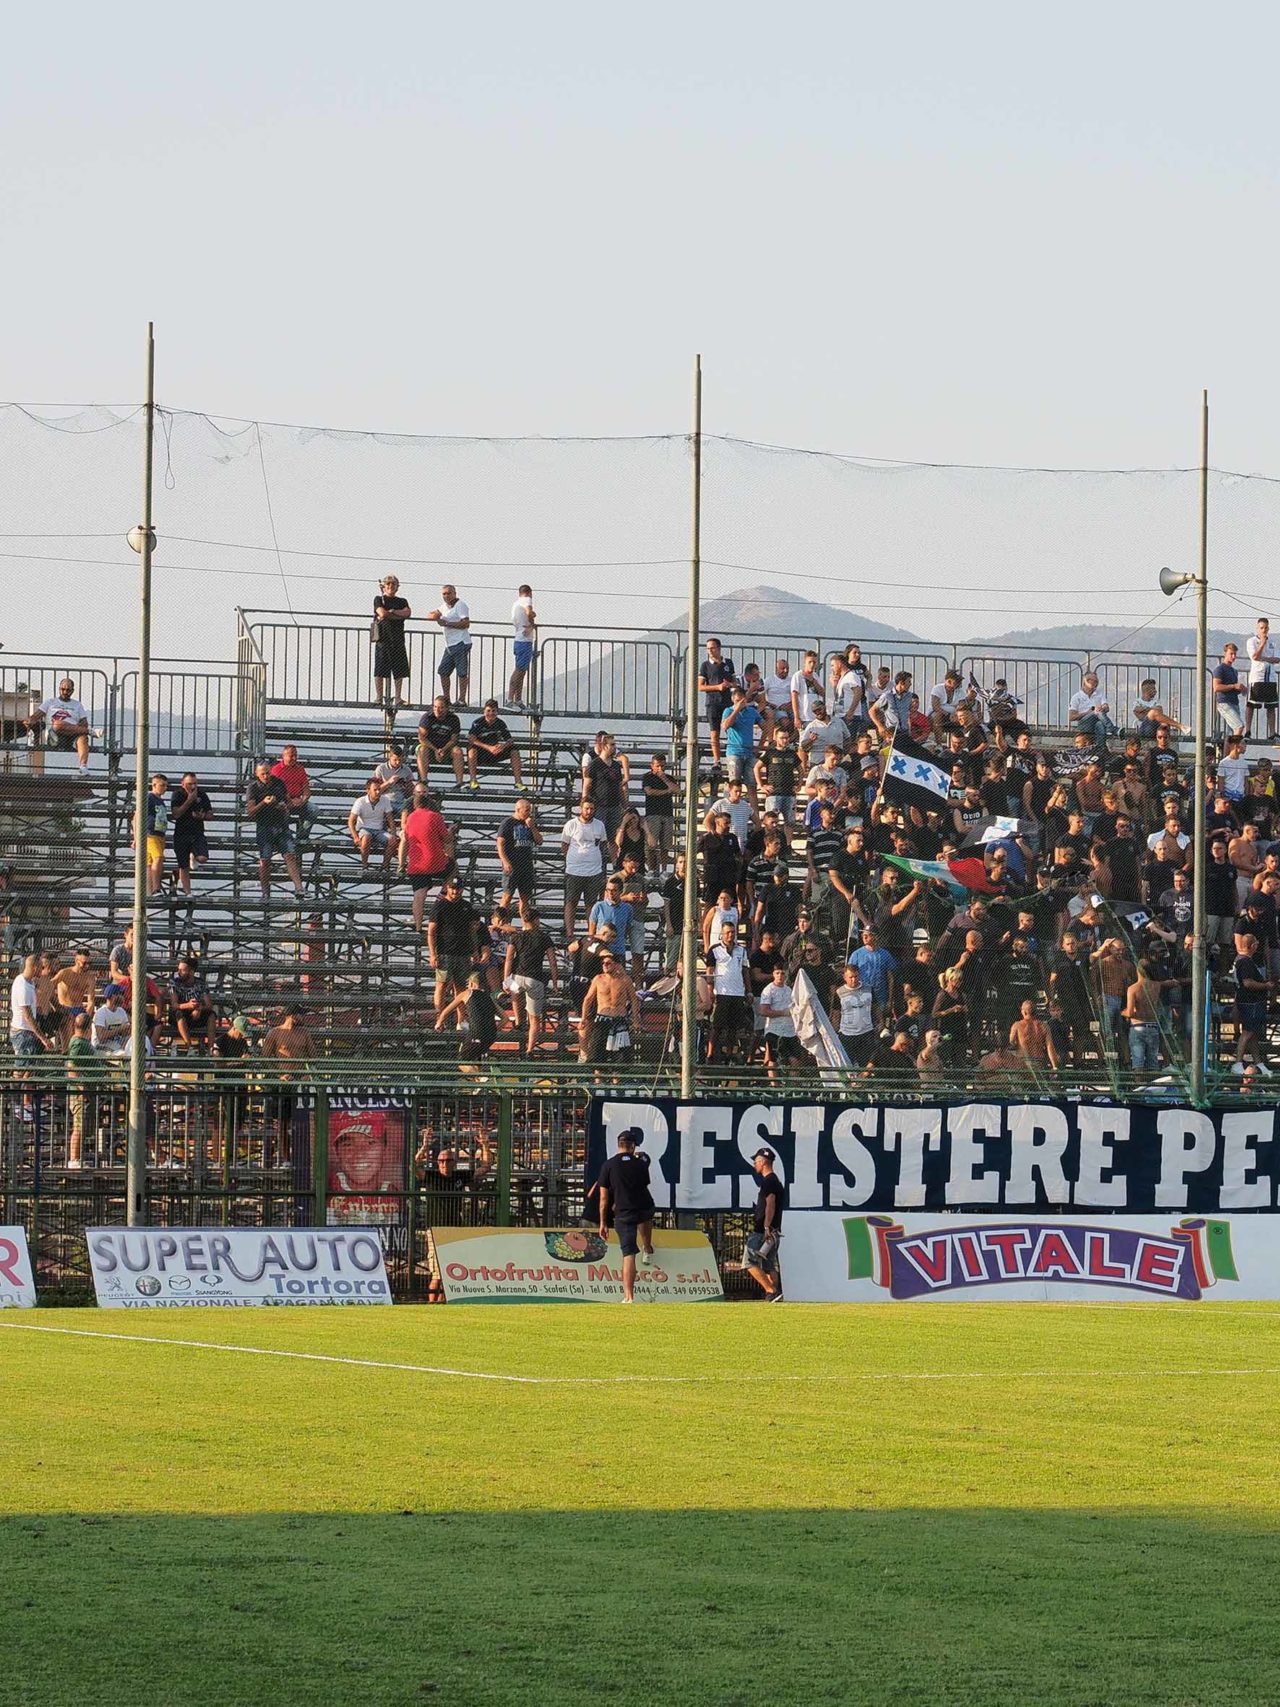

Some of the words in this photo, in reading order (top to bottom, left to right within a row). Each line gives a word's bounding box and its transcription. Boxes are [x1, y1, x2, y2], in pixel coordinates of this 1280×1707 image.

[603, 1102, 1130, 1210] RESISTERE
[92, 1234, 238, 1273] SUPER
[262, 1234, 381, 1272] AUTO
[898, 1227, 1187, 1290] VITALE
[269, 1274, 387, 1294] Tortora
[446, 1263, 580, 1281] Ortofrutta
[677, 1269, 717, 1284] s.r.l.
[449, 1284, 461, 1294] Via
[463, 1285, 486, 1294] Nuova
[544, 1284, 568, 1294] Scafati
[590, 1285, 604, 1294] Tel.
[604, 1286, 617, 1294] 081
[674, 1286, 687, 1295] 349
[689, 1286, 720, 1295] 6959538
[122, 1300, 151, 1309] VIA
[155, 1299, 257, 1308] NAZIONALE,
